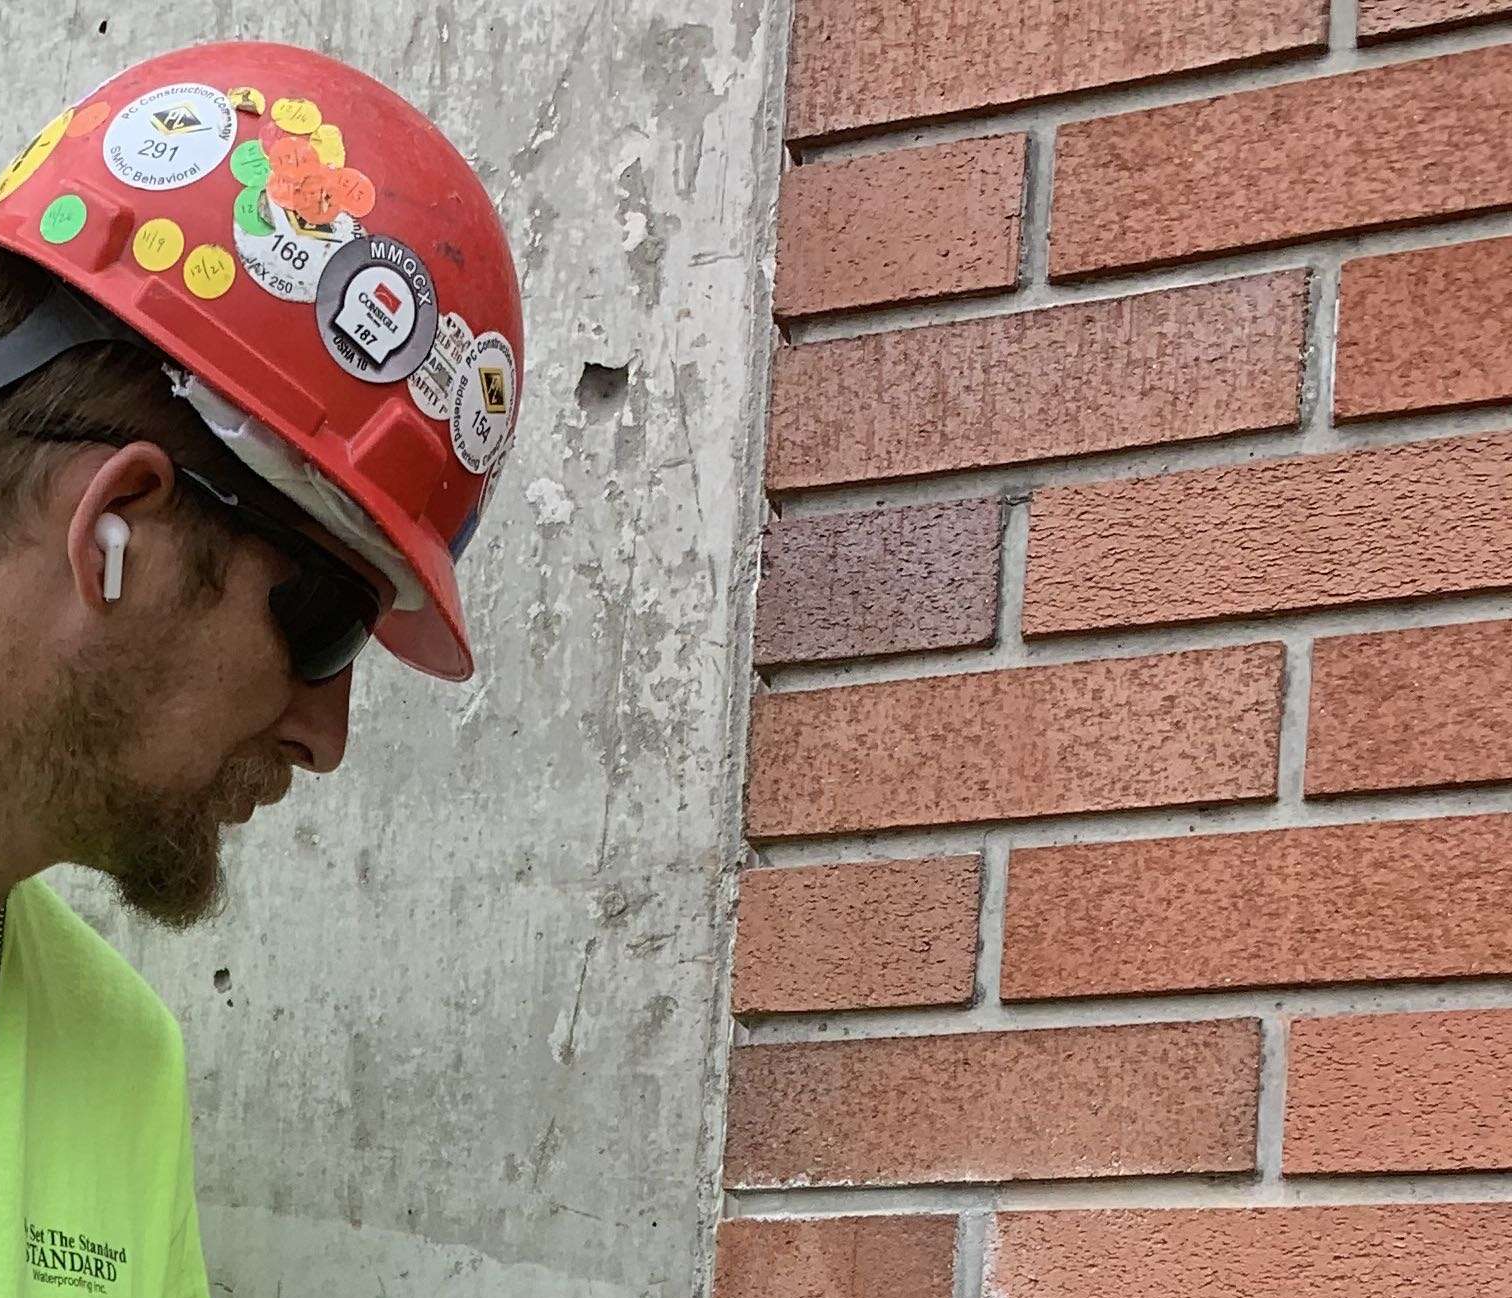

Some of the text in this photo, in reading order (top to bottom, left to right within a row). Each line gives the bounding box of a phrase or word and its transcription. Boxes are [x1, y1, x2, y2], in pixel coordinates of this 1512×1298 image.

[122, 86, 232, 141] PC Construction Company
[110, 145, 201, 185] SMHC Behavioral
[138, 139, 179, 162] 291
[190, 256, 224, 280] 12/21
[272, 235, 309, 270] 168
[269, 276, 293, 293] 250
[370, 241, 433, 307] MMQCX
[353, 324, 378, 346] 187
[466, 348, 477, 369] PC
[471, 410, 492, 444] 154
[29, 1223, 45, 1243] Set
[47, 1229, 75, 1248] The
[79, 1234, 128, 1263] Standard
